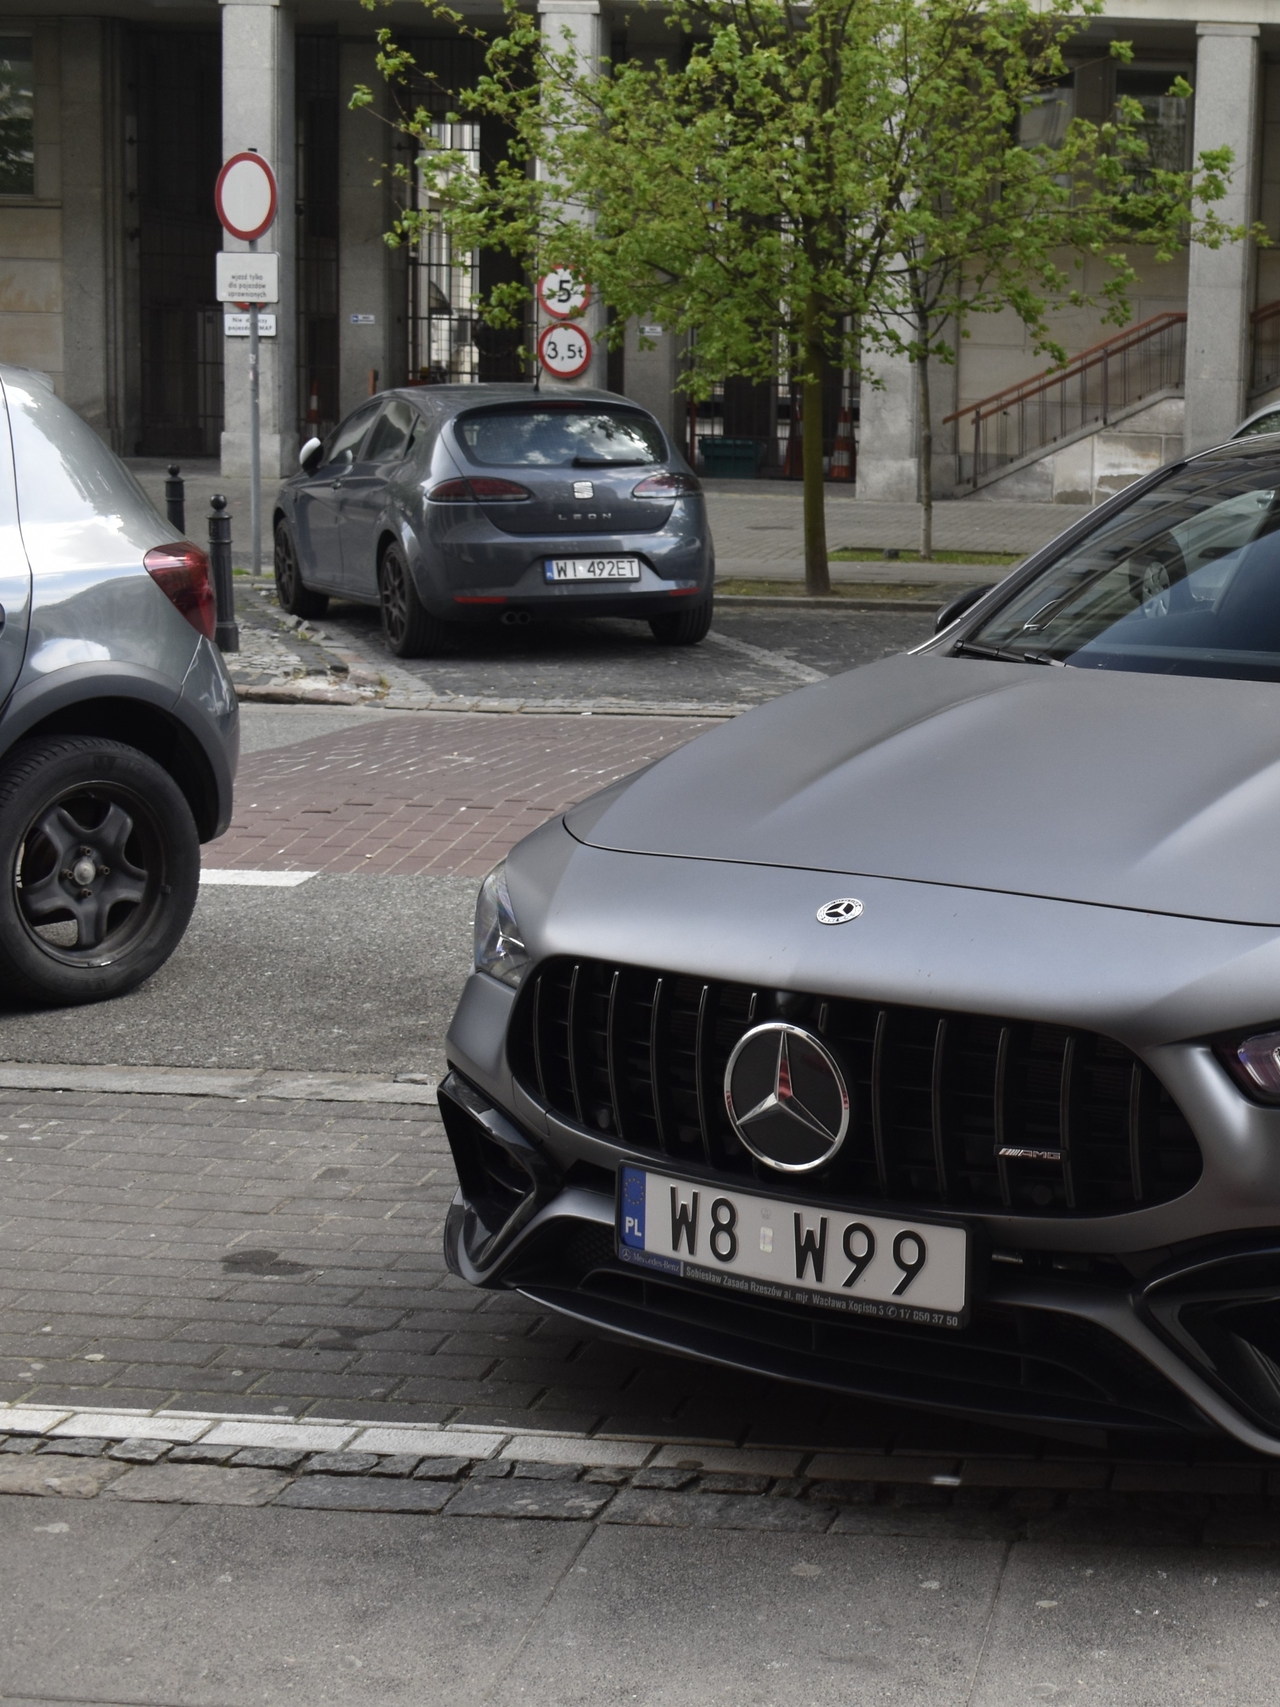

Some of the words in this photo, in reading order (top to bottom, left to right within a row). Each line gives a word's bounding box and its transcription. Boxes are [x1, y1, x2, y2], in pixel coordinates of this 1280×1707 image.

[249, 274, 264, 282] tylko
[557, 280, 572, 303] 5
[547, 341, 583, 361] 3,5t
[556, 561, 577, 578] WI
[587, 560, 635, 577] 492ET
[625, 1216, 642, 1238] PL
[669, 1184, 740, 1264] W8
[793, 1210, 928, 1297] W99
[633, 1251, 680, 1273] Mercedes-Benz
[686, 1266, 722, 1284] Sobiesław
[723, 1275, 749, 1290] Zasada
[750, 1281, 782, 1297] Rzeszów
[812, 1293, 847, 1309] Wacława
[932, 1313, 944, 1324] 37
[946, 1315, 958, 1327] 50
